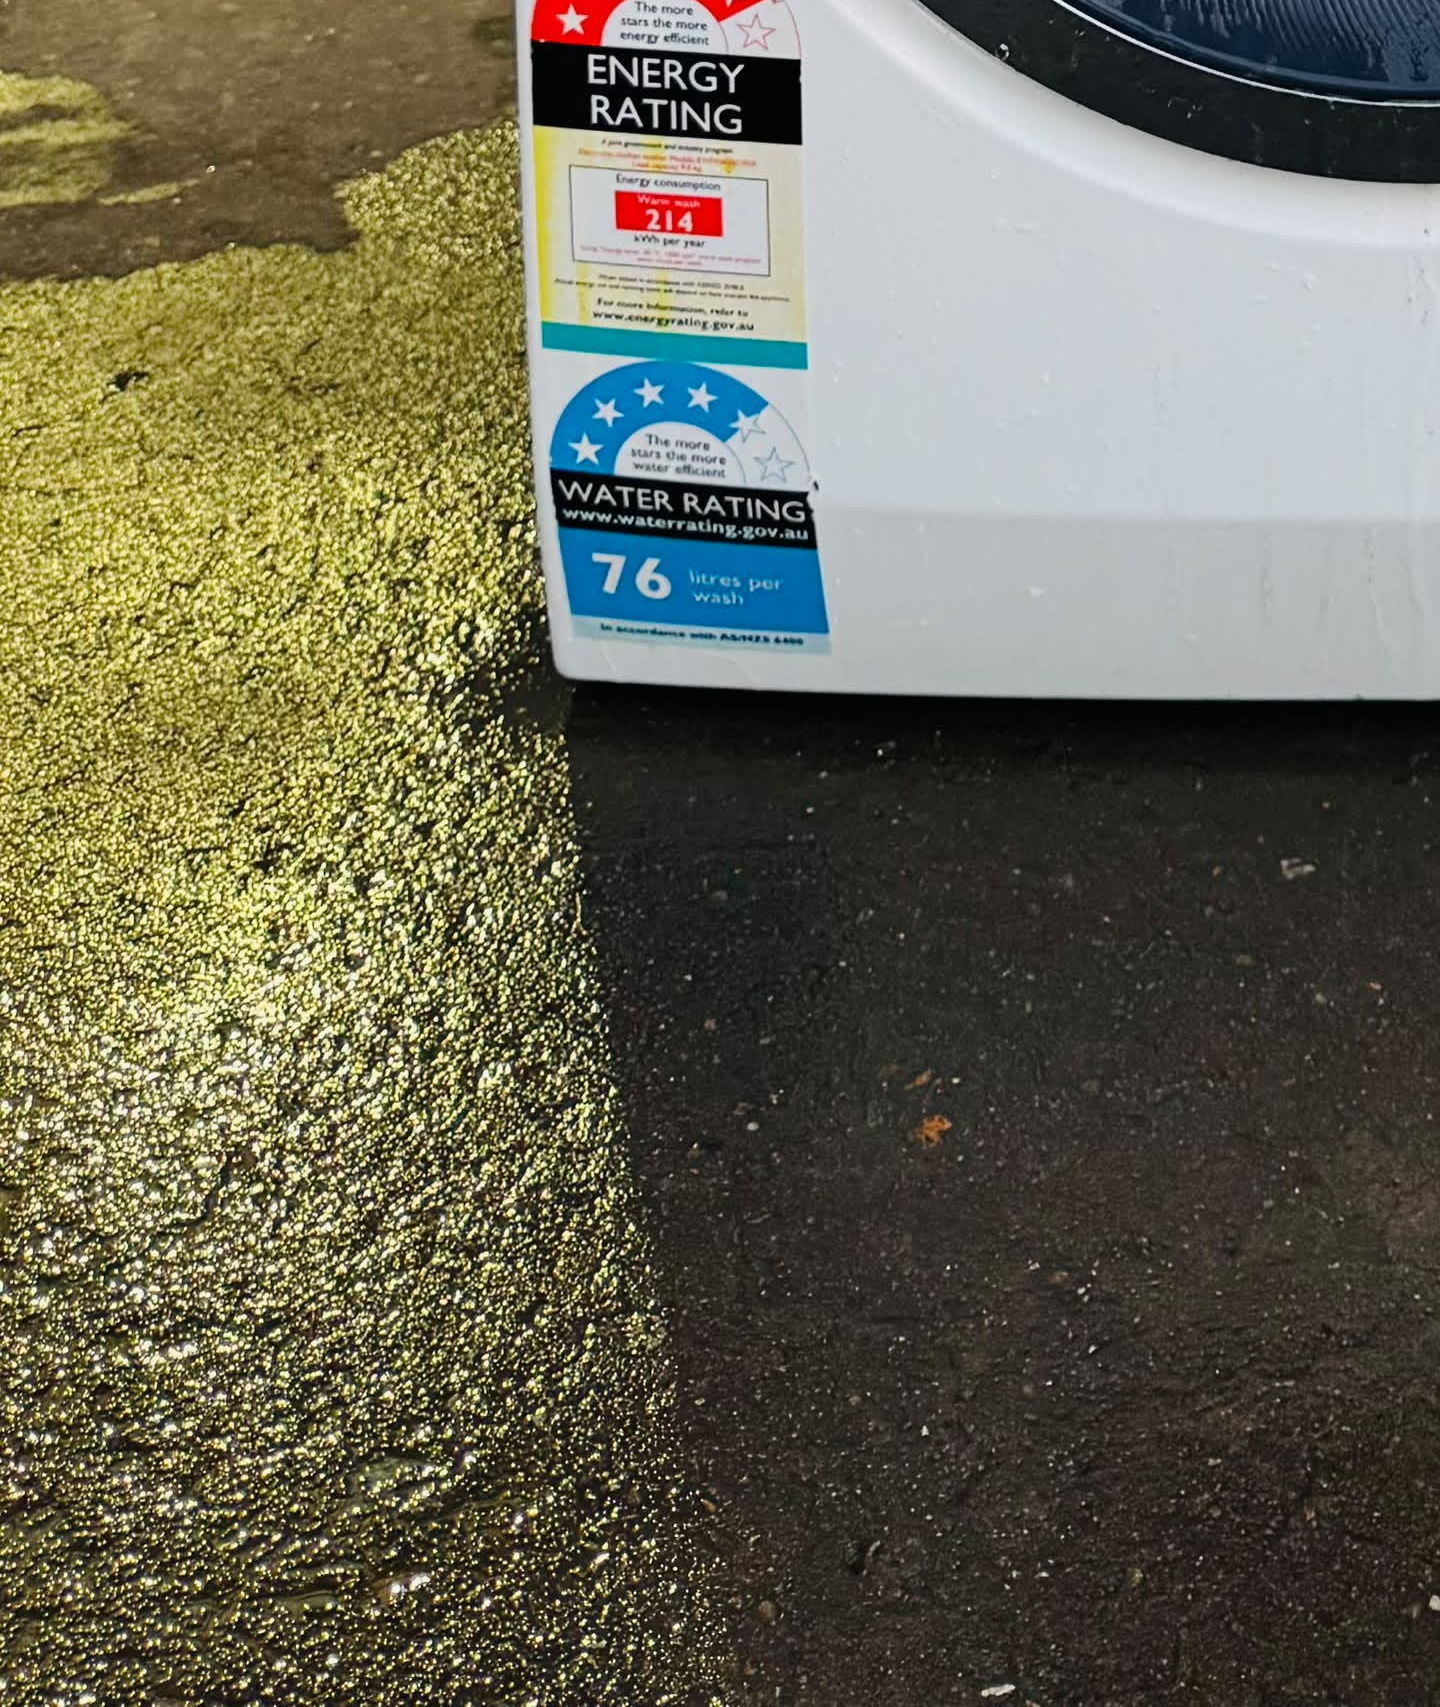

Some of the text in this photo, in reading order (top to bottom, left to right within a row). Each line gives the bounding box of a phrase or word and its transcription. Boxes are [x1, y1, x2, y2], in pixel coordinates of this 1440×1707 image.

[635, 1, 693, 15] The more
[621, 17, 707, 31] stars the more
[620, 32, 709, 45] energy efficient
[587, 54, 745, 93] ENERGY
[590, 95, 743, 135] RATING
[616, 173, 721, 191] Energy consumption
[637, 195, 701, 208] Warm wash
[645, 209, 693, 232] 214
[634, 234, 705, 249] kWh per year
[597, 297, 614, 307] For
[616, 301, 643, 310] more
[592, 310, 755, 331] www.energyrating.gov.au
[646, 434, 710, 451] The more
[631, 448, 726, 466] stars the more
[632, 462, 726, 479] water efficient
[558, 479, 806, 523] WATER RATING
[562, 508, 808, 540] www.waterrating.gov.au
[592, 552, 672, 600] 76
[688, 568, 783, 592] litres per
[692, 591, 744, 605] wash
